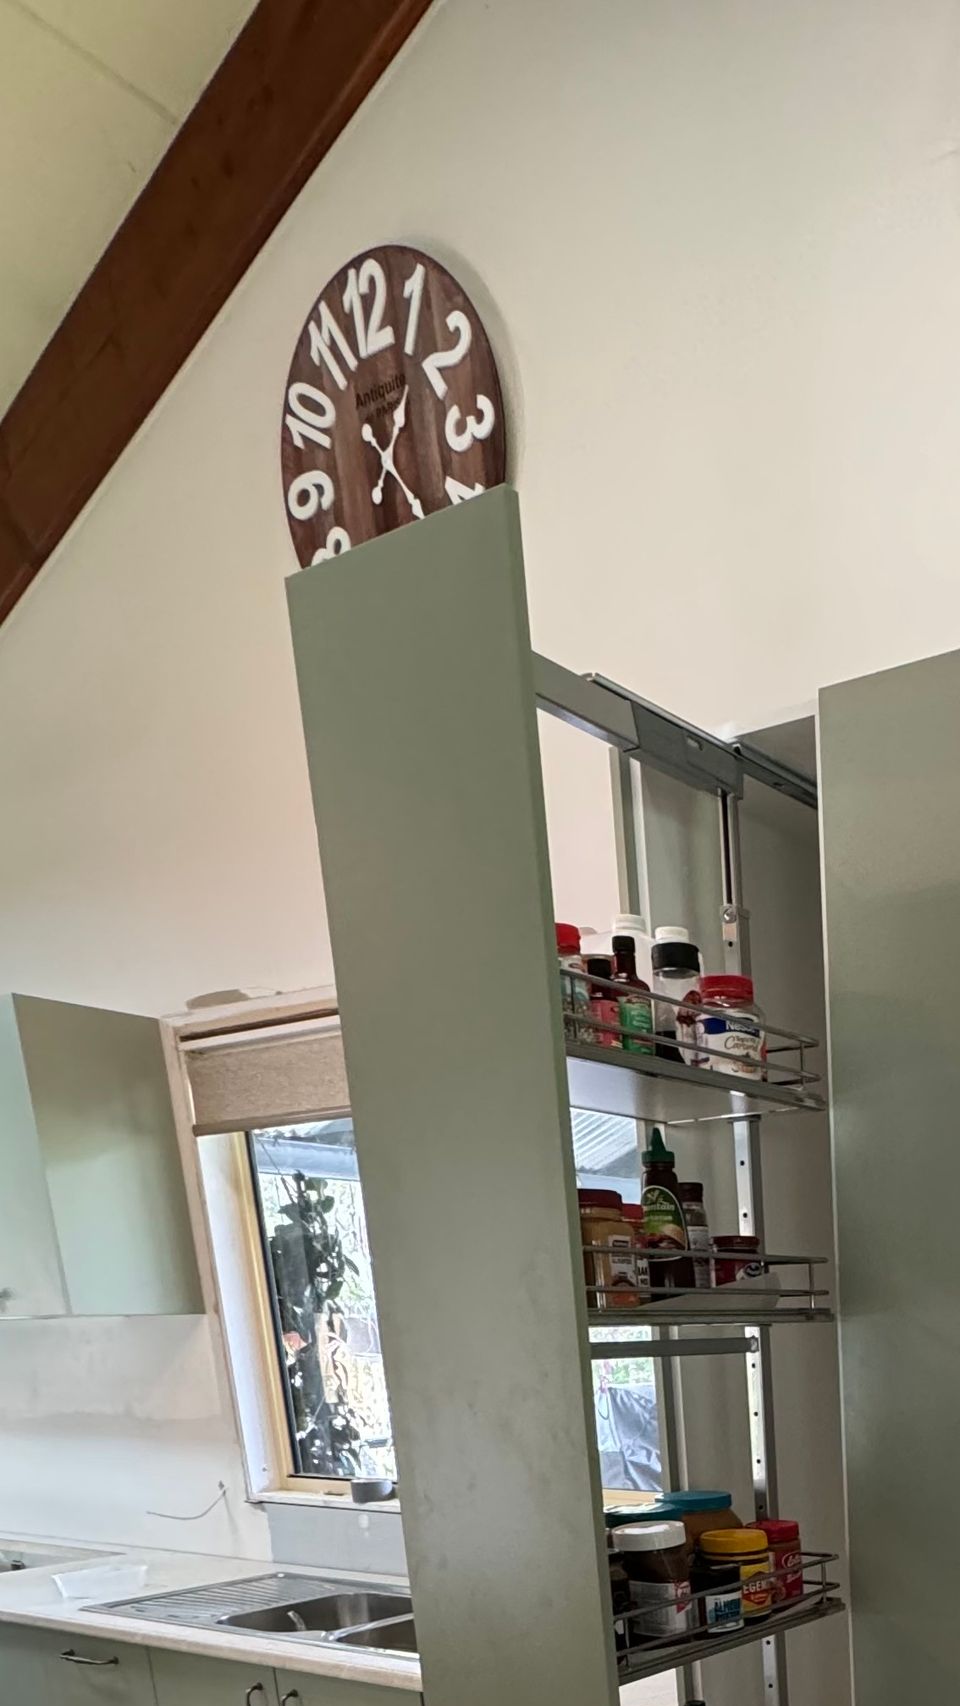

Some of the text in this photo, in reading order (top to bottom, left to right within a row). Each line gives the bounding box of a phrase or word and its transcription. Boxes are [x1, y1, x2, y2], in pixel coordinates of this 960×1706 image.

[308, 300, 359, 391] 11
[342, 258, 396, 360] 12
[403, 263, 427, 357] 1
[421, 310, 473, 401] 2
[285, 382, 337, 450] 10
[445, 394, 495, 452] 3
[287, 470, 335, 521] 9
